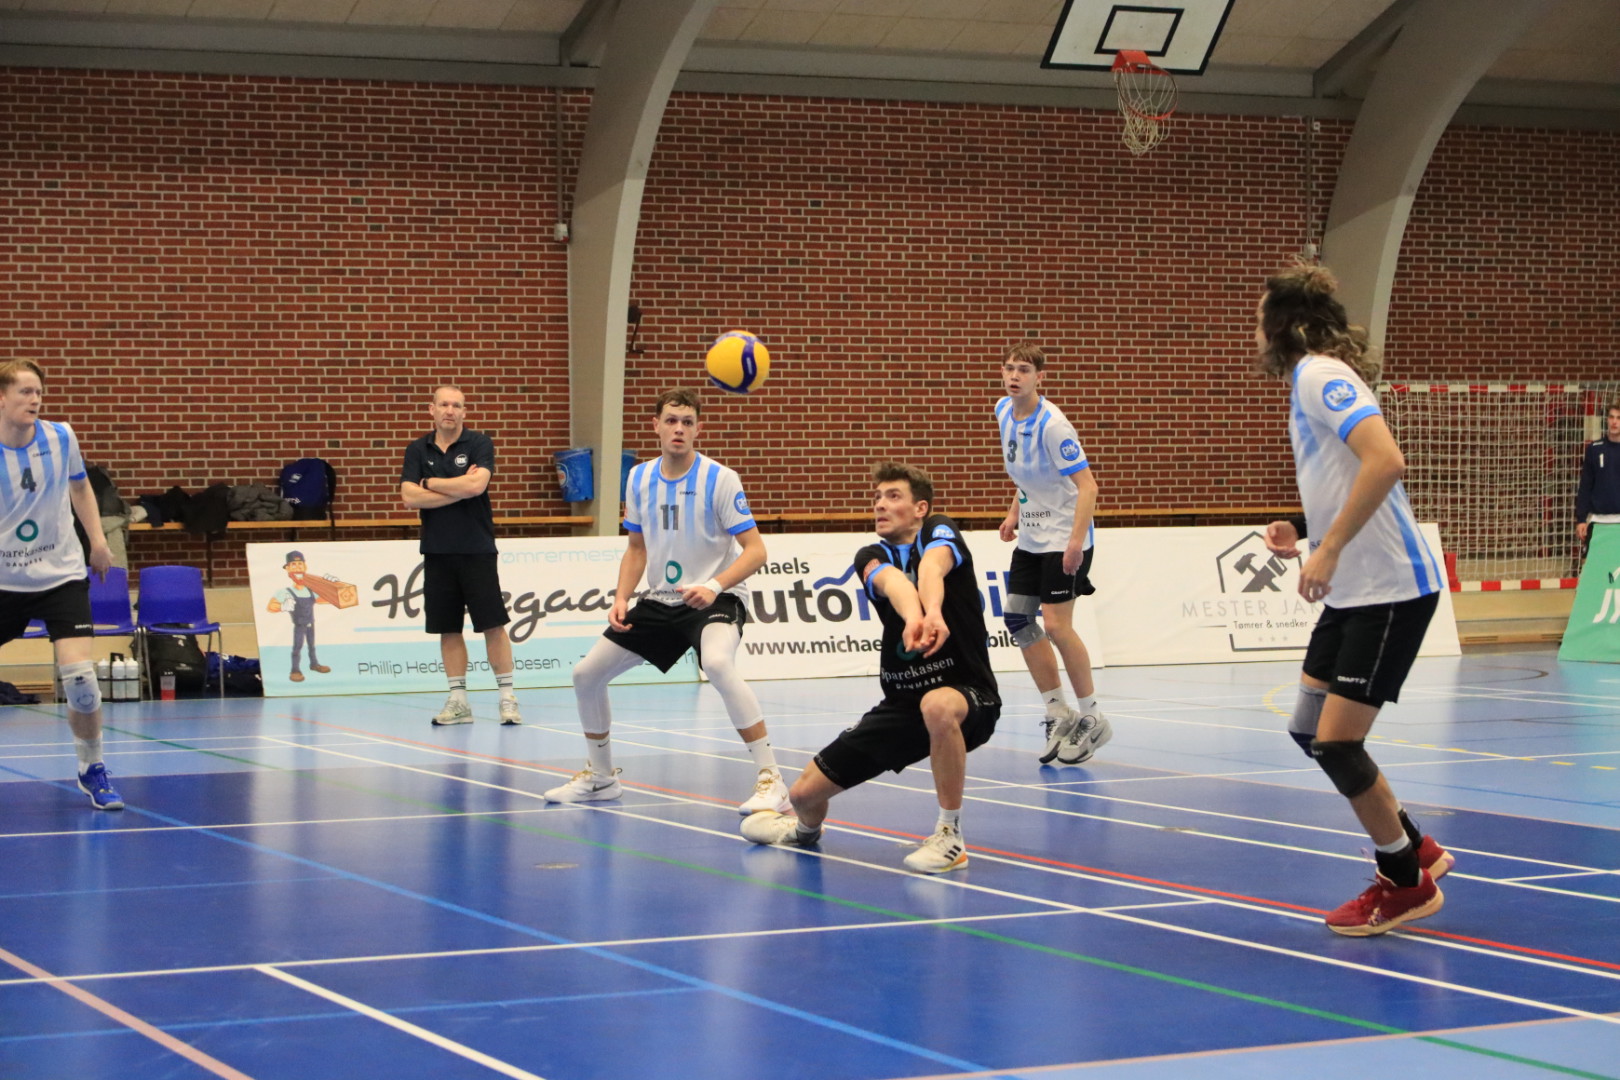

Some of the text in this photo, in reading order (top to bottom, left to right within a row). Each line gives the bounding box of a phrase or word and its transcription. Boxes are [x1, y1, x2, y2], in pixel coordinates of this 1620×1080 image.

[1007, 440, 1018, 463] 3
[20, 467, 37, 493] 4
[660, 504, 679, 530] 11
[501, 547, 625, 564] ømrermest
[1182, 599, 1321, 618] MESTER JAK
[1233, 619, 1308, 629] Tømrer & snedker
[358, 660, 403, 678] Phillip
